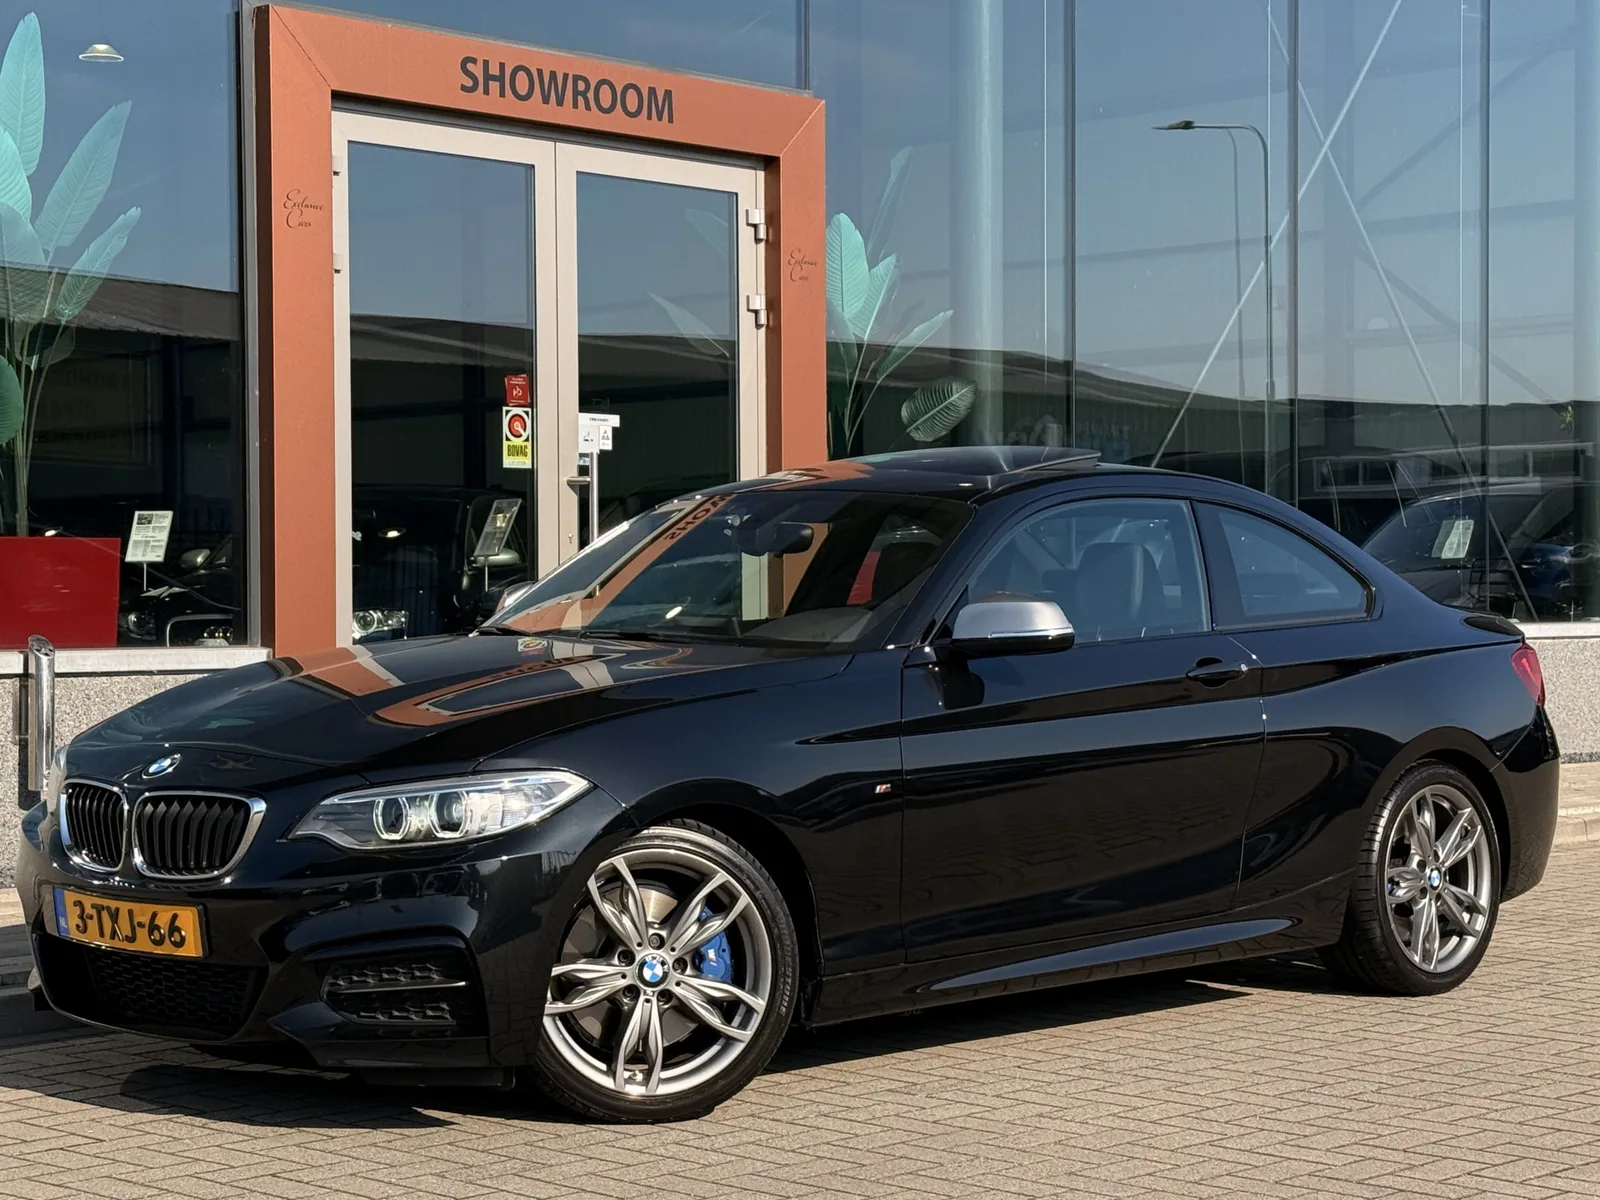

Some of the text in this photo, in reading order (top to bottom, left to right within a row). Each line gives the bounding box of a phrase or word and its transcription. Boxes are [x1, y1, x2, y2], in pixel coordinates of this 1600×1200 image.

[459, 55, 675, 124] SHOWROOM
[507, 444, 529, 458] BOVAG
[72, 899, 187, 949] 3-TXJ-66
